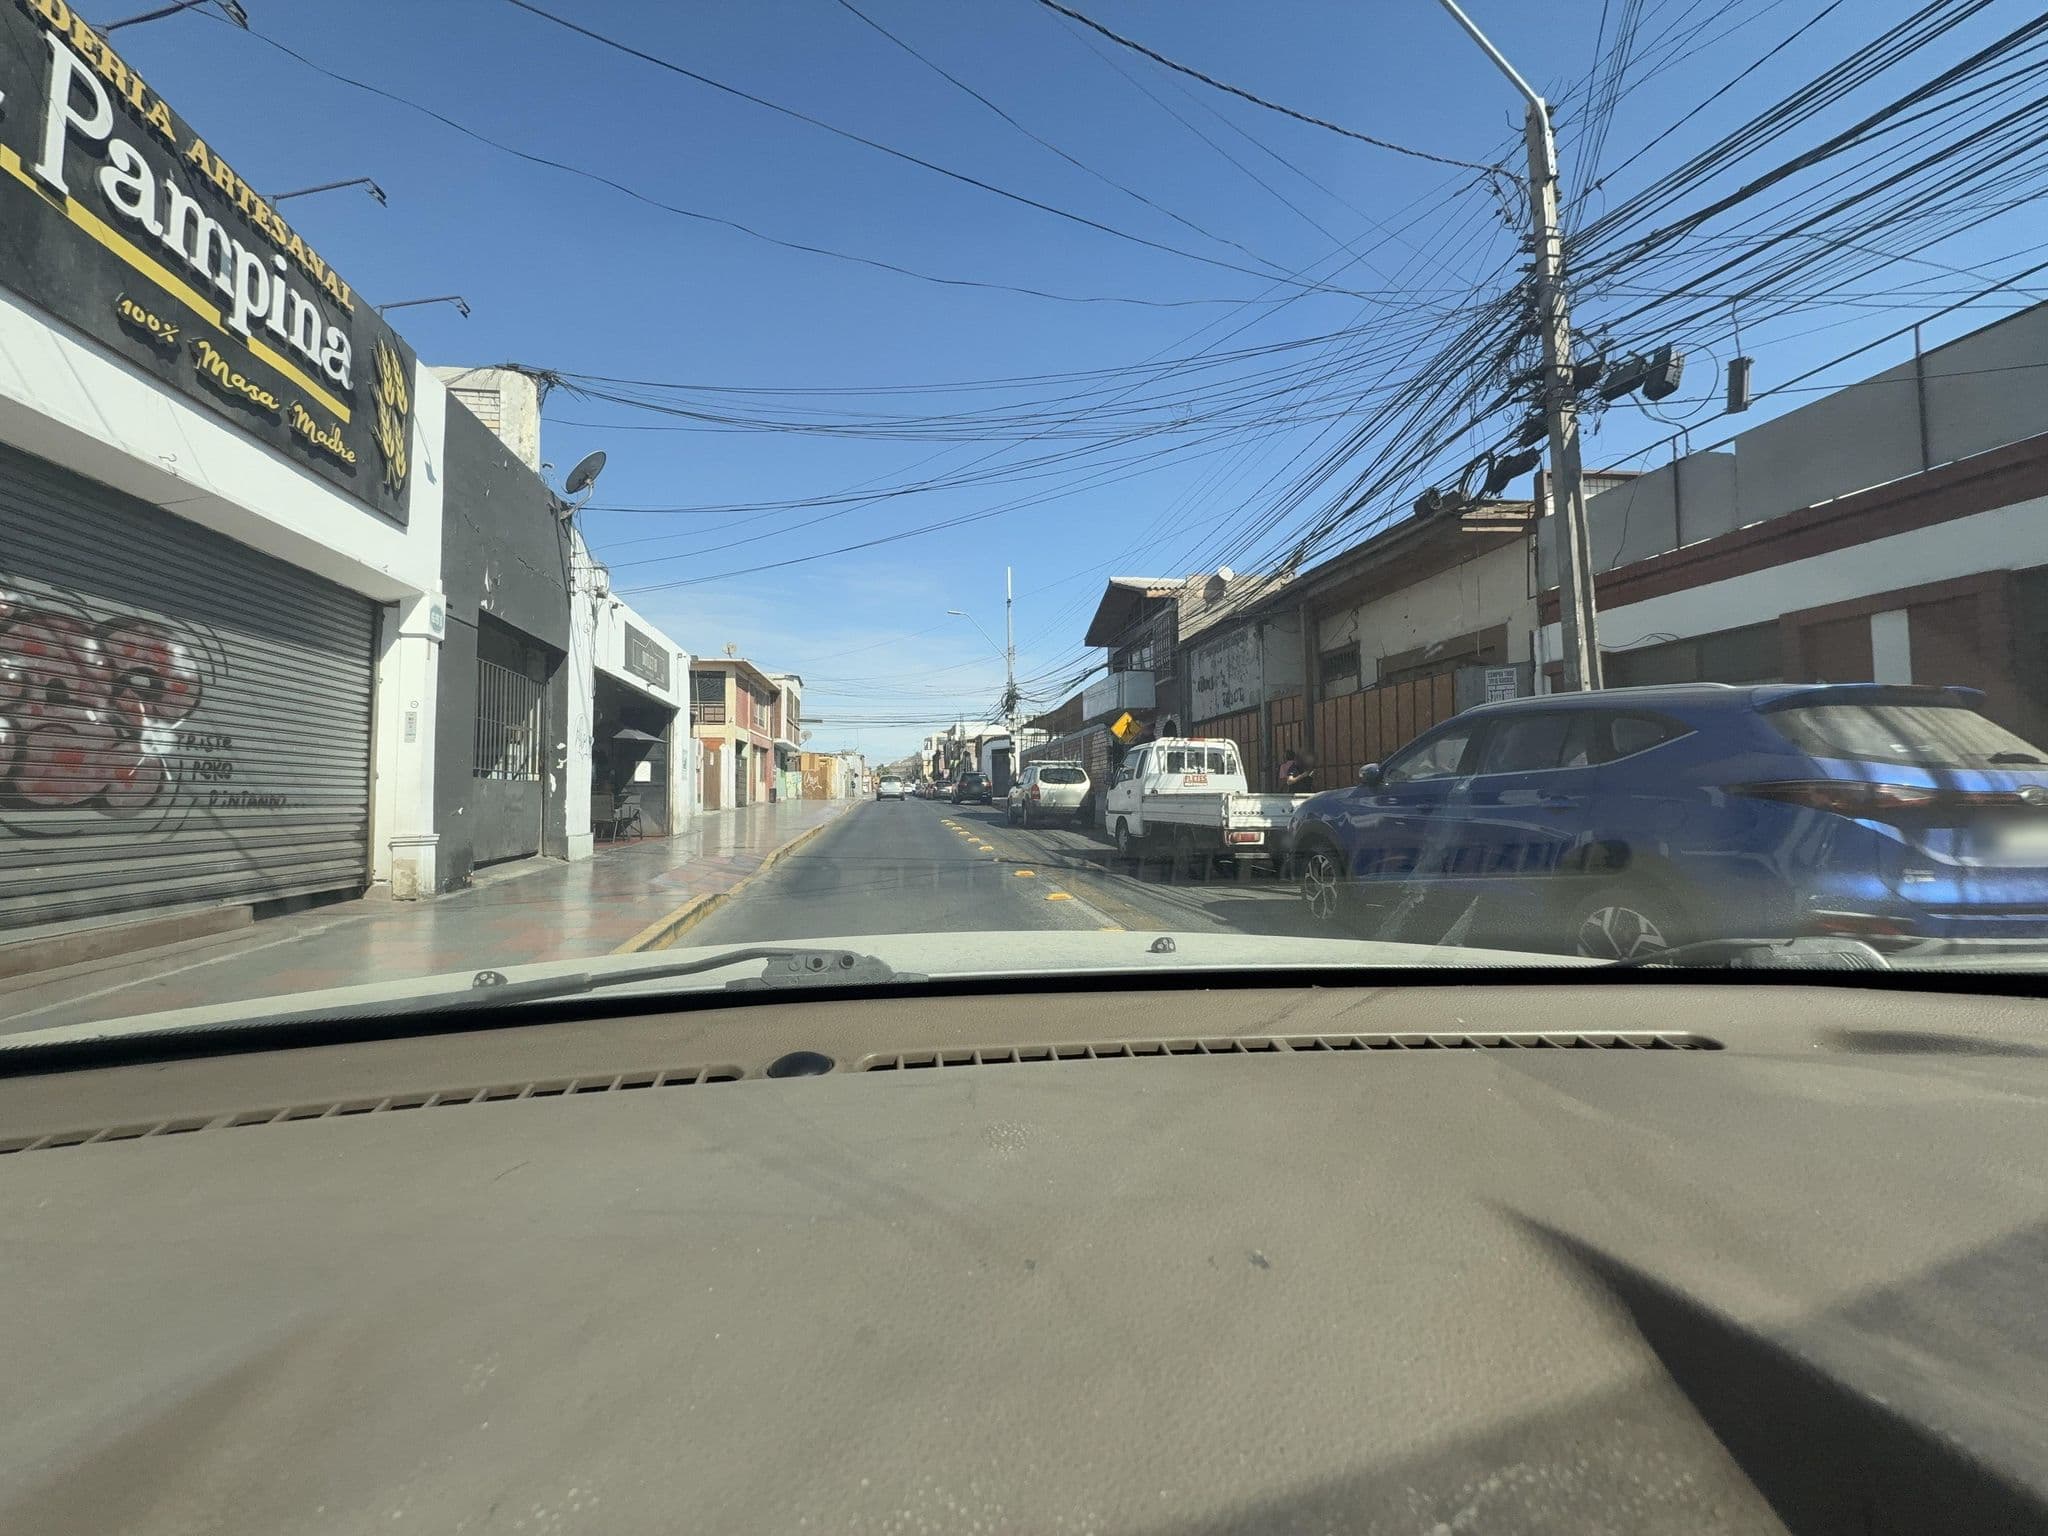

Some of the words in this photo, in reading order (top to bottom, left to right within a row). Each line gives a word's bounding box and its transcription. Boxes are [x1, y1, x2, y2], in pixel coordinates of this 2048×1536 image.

[34, 29, 353, 391] Pampina
[186, 138, 355, 312] ARTESANAL
[121, 299, 180, 343] 100%
[198, 341, 280, 410] Masa
[294, 404, 356, 463] Madre
